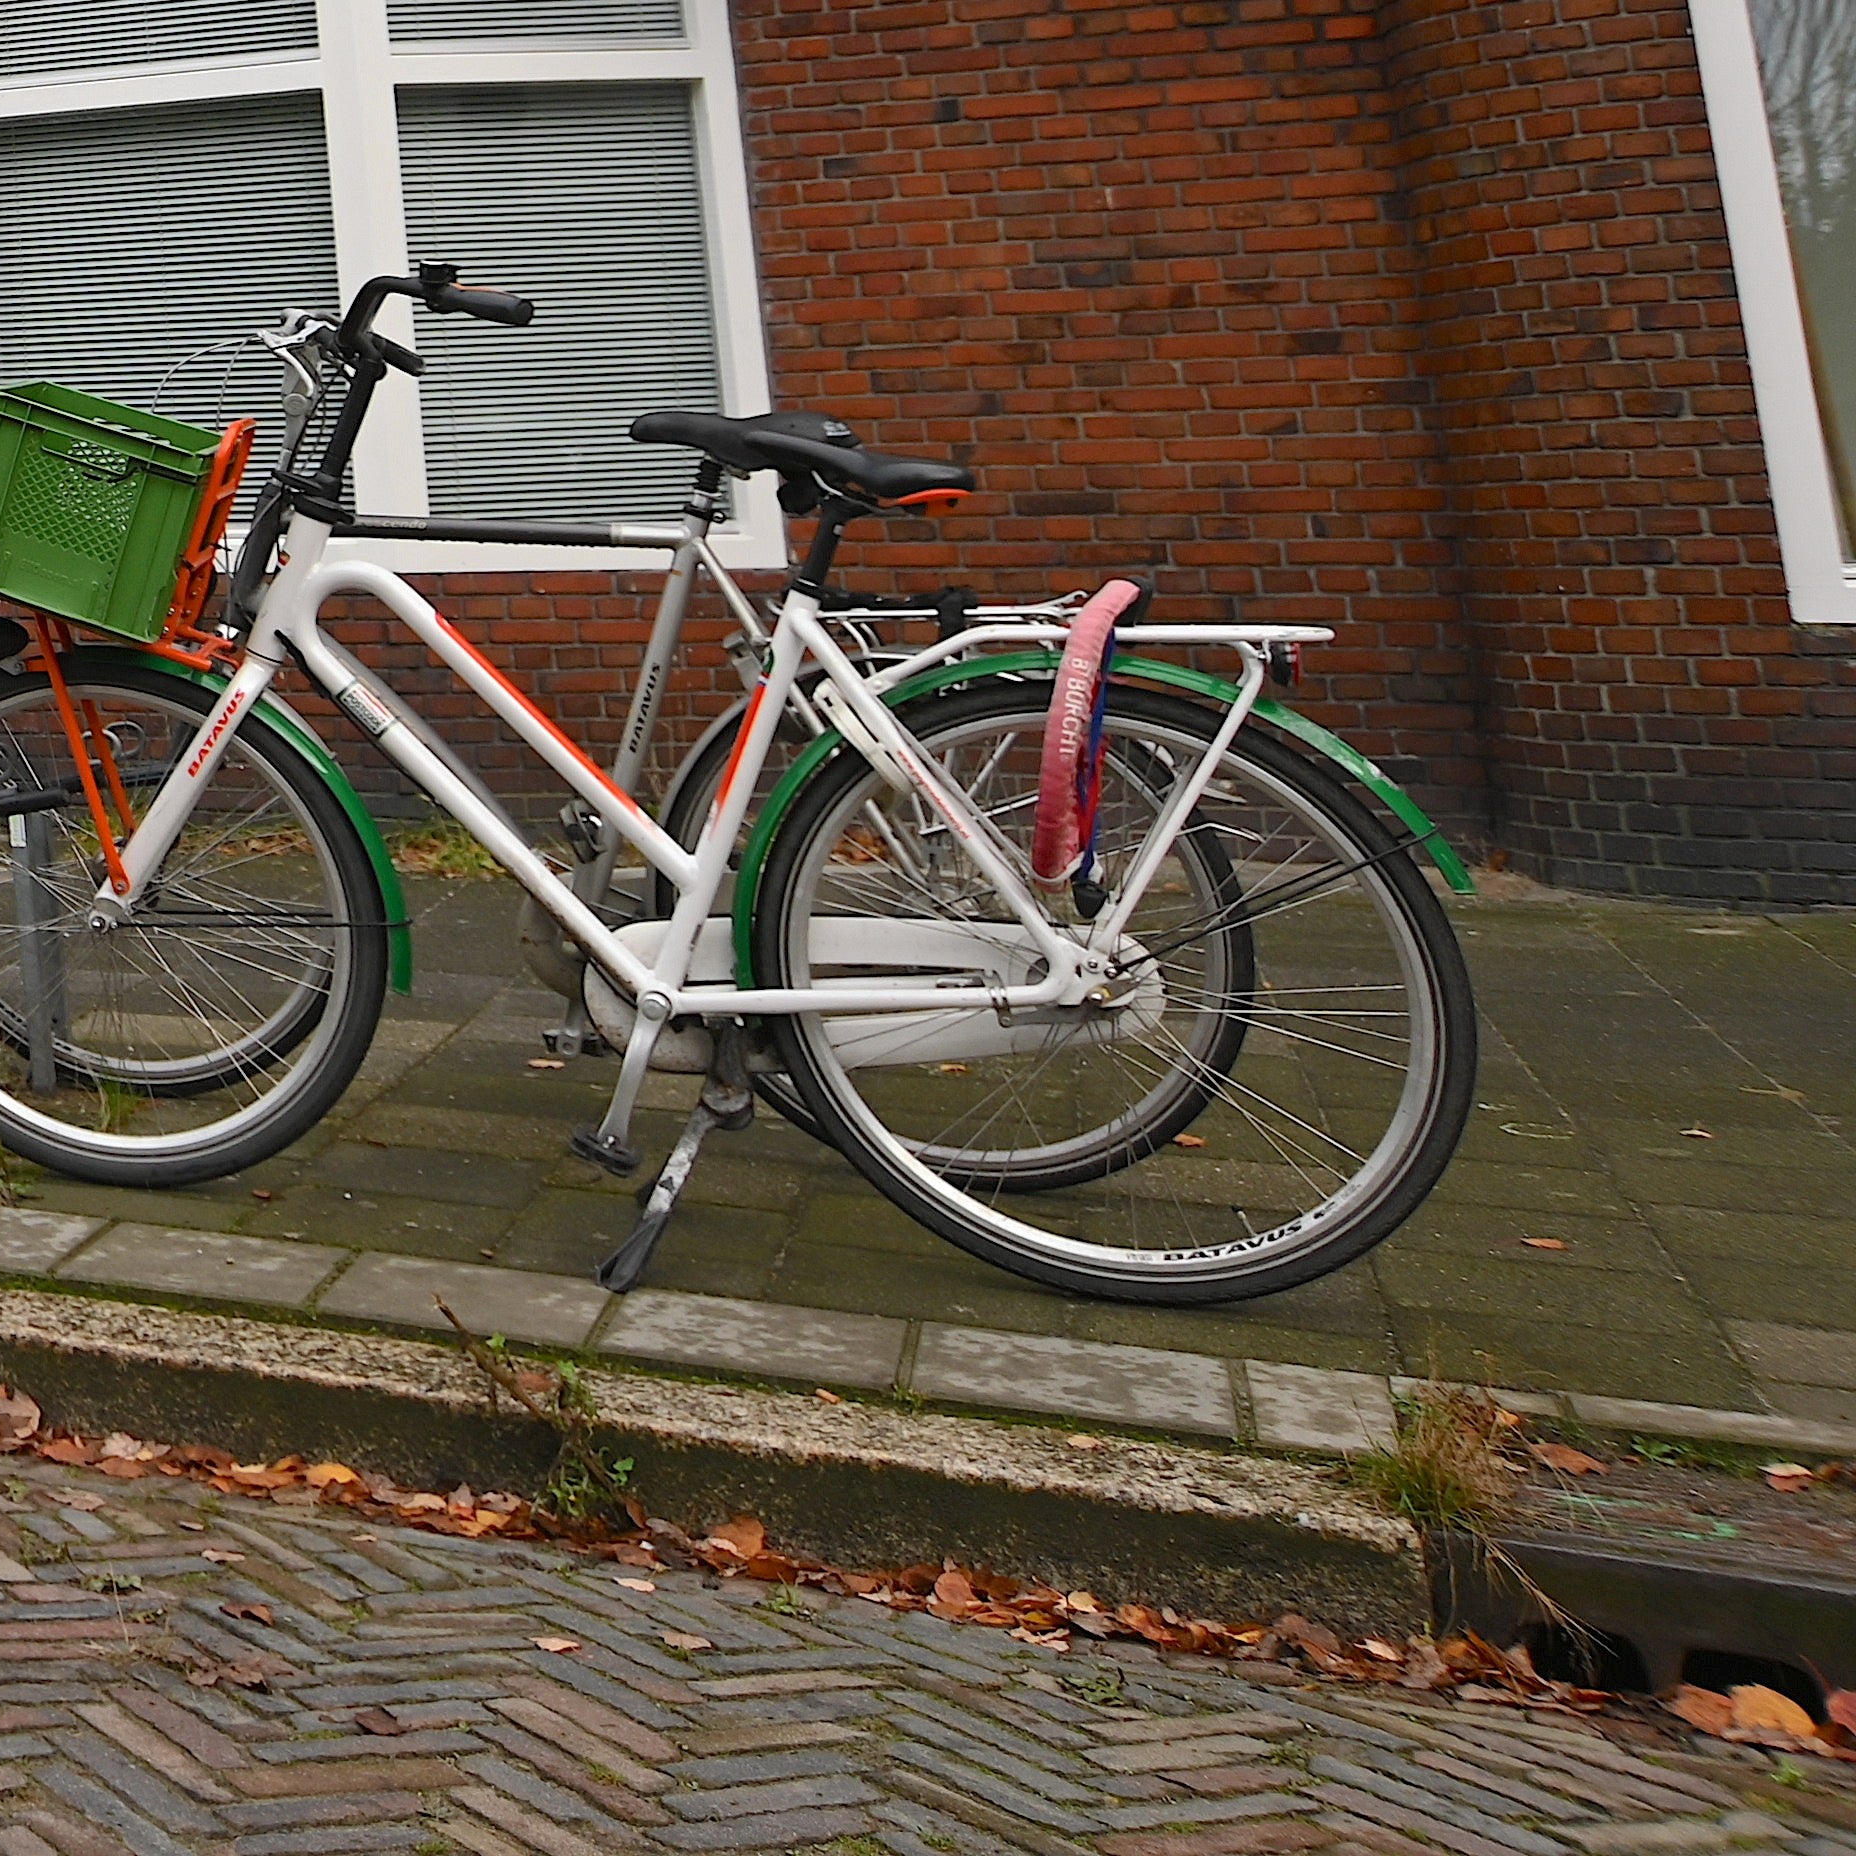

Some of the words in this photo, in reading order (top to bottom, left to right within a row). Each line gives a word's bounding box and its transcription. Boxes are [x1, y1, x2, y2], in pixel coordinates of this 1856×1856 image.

[188, 688, 246, 778] BATAVUS
[630, 663, 660, 753] BATAVUS
[1163, 1220, 1303, 1262] BATAVUS
